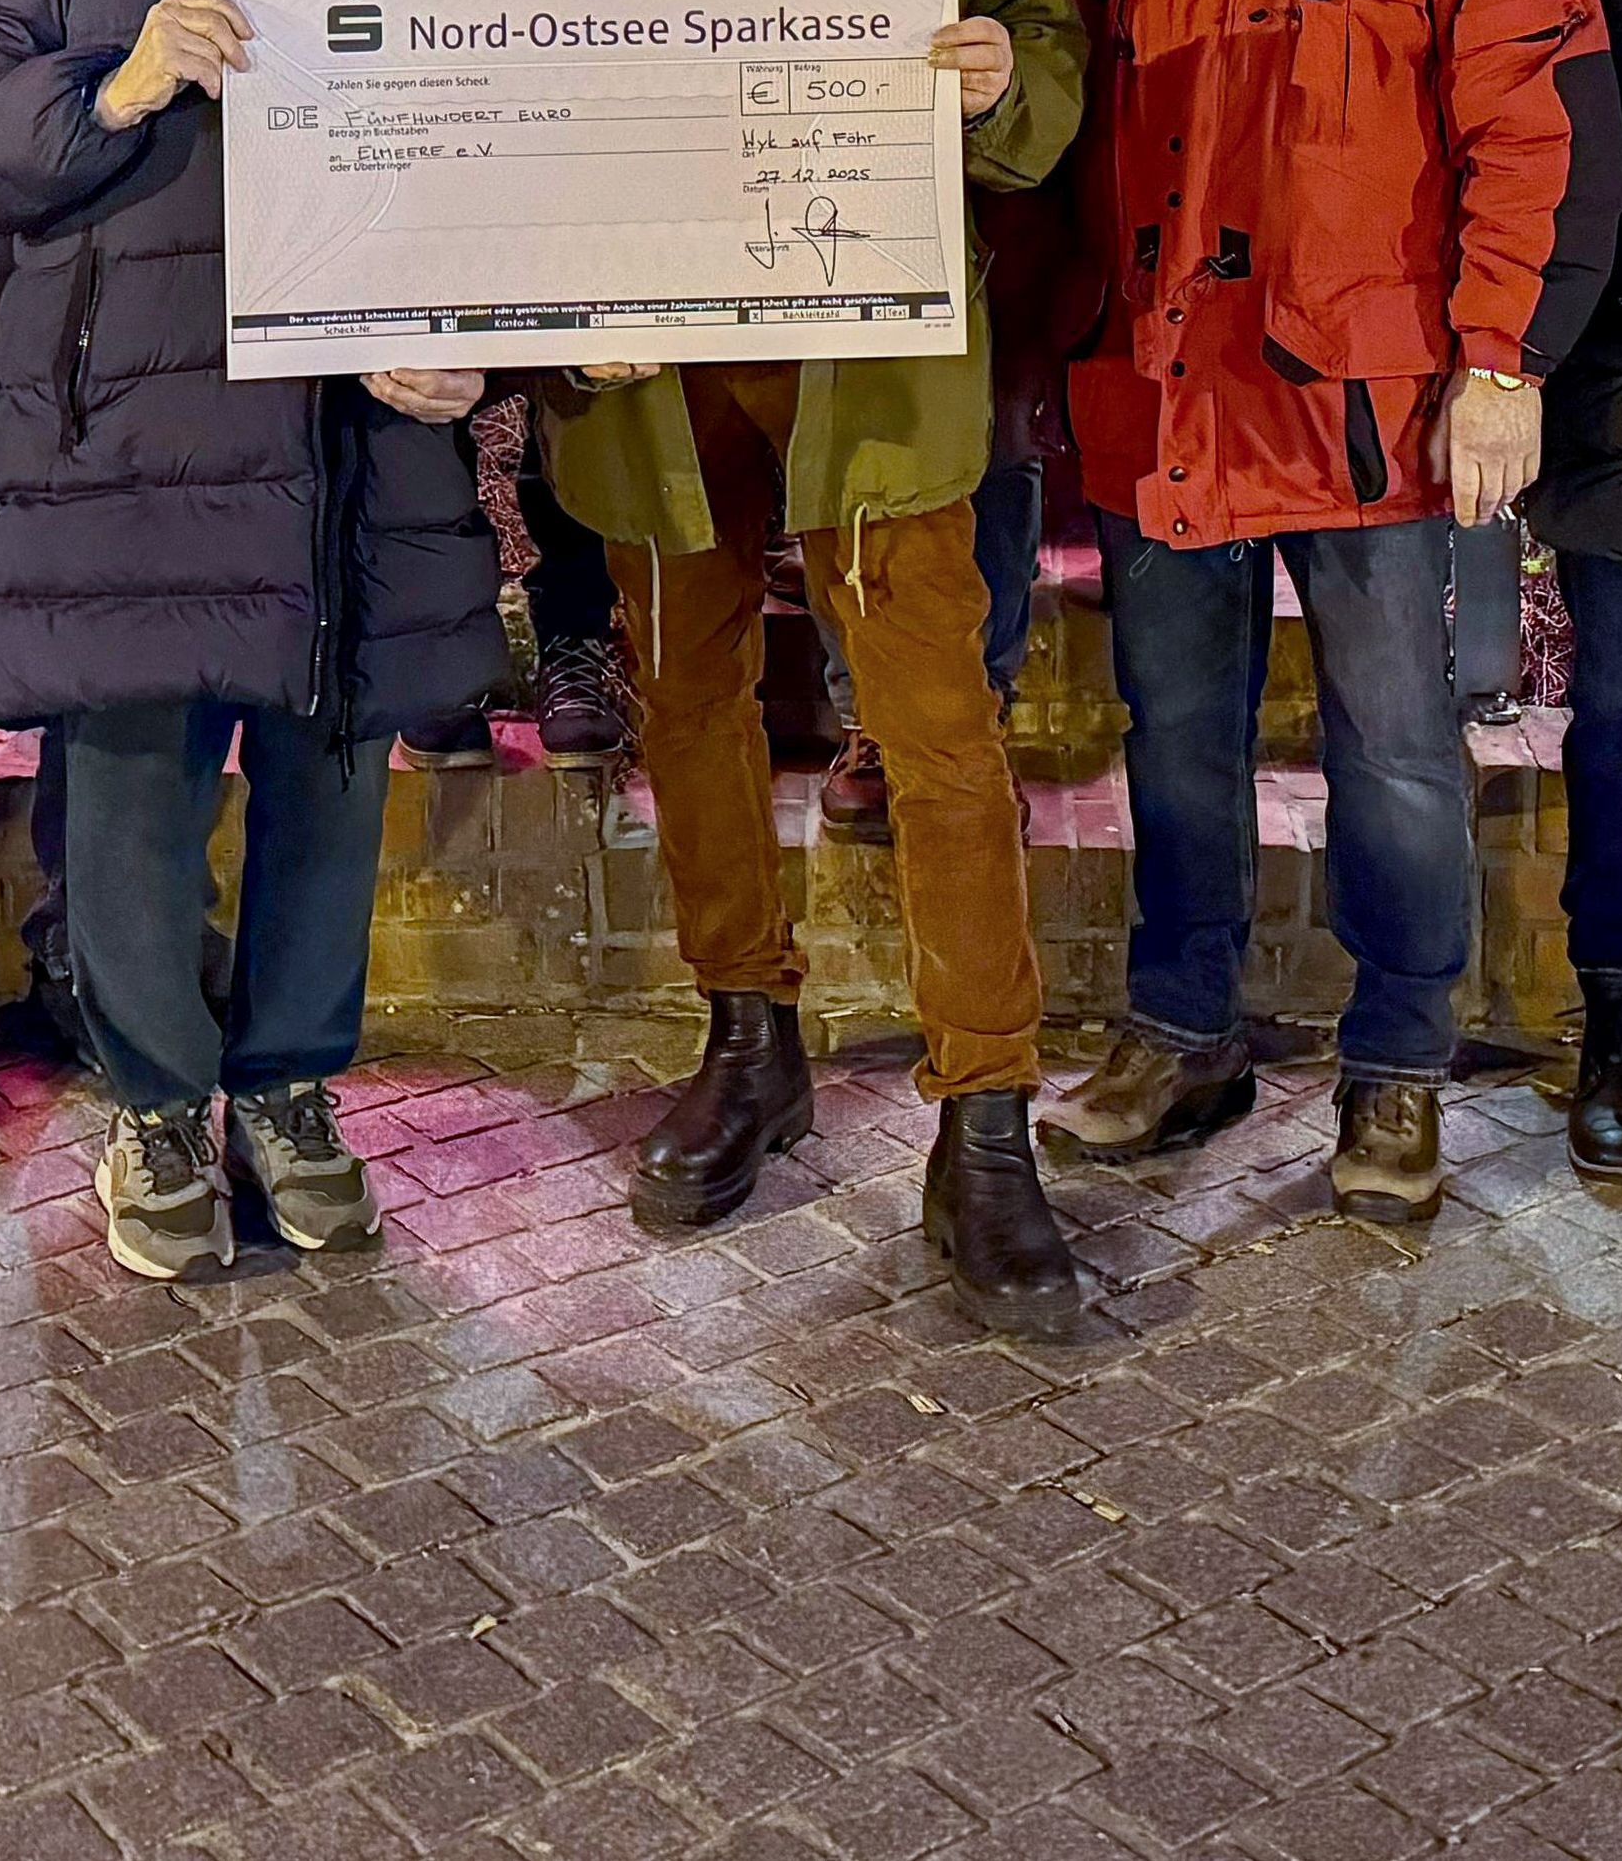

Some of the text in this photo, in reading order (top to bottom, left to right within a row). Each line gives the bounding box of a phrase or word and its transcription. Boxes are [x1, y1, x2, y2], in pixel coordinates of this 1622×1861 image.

[409, 11, 669, 52] Nord-Ostsee
[683, 5, 893, 54] Sparkasse
[327, 75, 490, 91] Zahlen Sie gegen diesen Scheck
[747, 81, 780, 106] €
[267, 105, 319, 131] DE
[518, 108, 571, 123] EURO
[328, 128, 361, 139] Betrag
[742, 128, 877, 154] Wyk auf Föhr
[357, 145, 445, 161] ELMEERE
[329, 162, 352, 172] oder
[654, 314, 687, 325] Betrag
